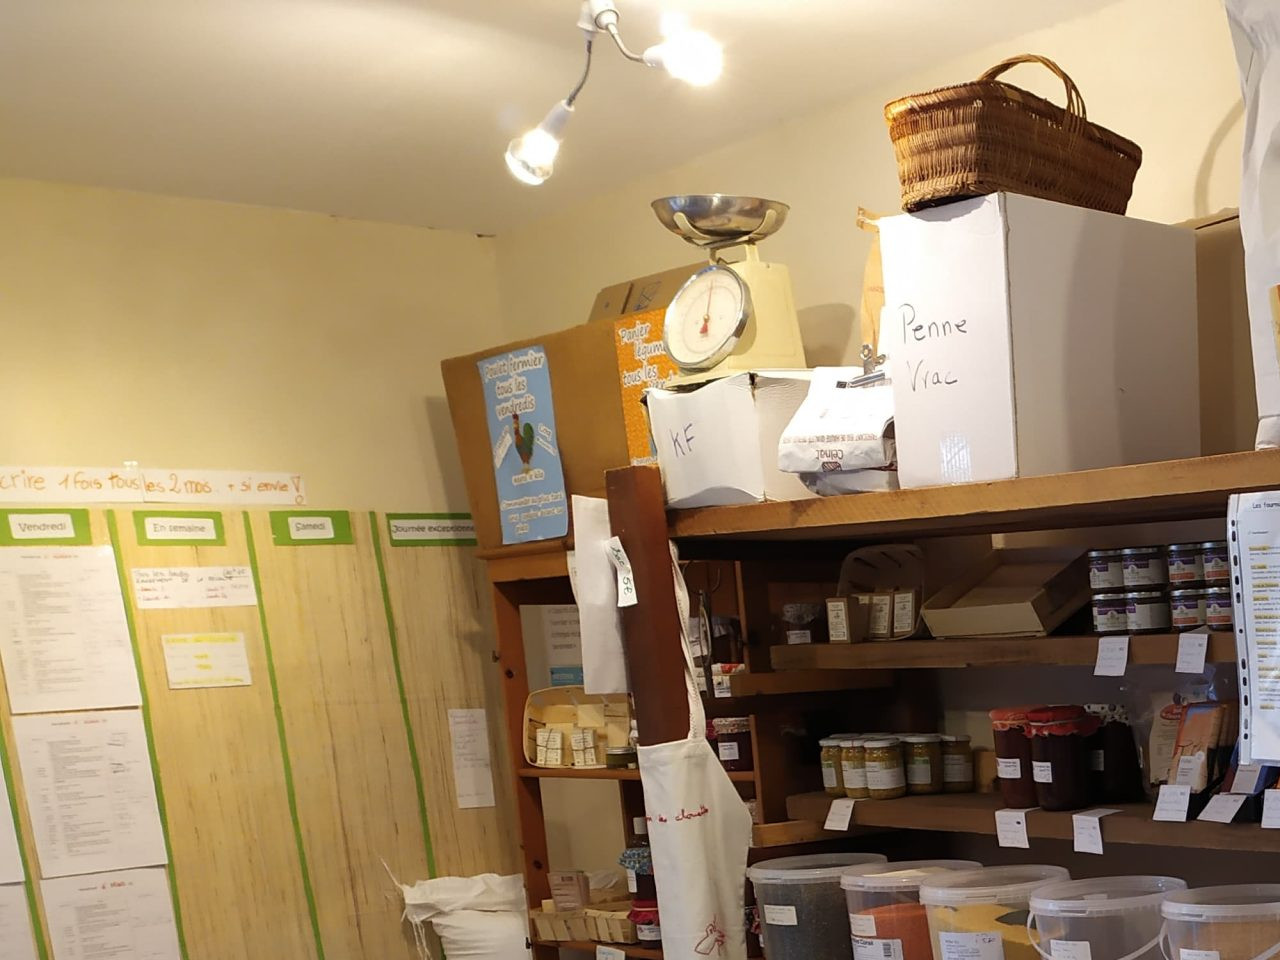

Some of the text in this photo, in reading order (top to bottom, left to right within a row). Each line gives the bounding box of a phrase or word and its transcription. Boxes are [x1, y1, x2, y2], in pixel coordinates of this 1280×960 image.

[620, 322, 648, 342] Panier
[899, 303, 967, 344] Penne
[485, 352, 546, 378] Poulet fermier
[623, 363, 658, 386] tous les
[906, 359, 959, 393] Vrac
[495, 377, 527, 398] tous les
[495, 395, 536, 418] vendredis
[814, 448, 845, 461] Celnat
[107, 472, 140, 491] tous
[168, 472, 182, 493] 2
[239, 474, 252, 493] si
[256, 476, 290, 493] envie
[18, 520, 68, 533] Vendredi
[153, 523, 207, 534] En semaine
[294, 521, 327, 532] Samedi
[391, 522, 426, 535] Journée
